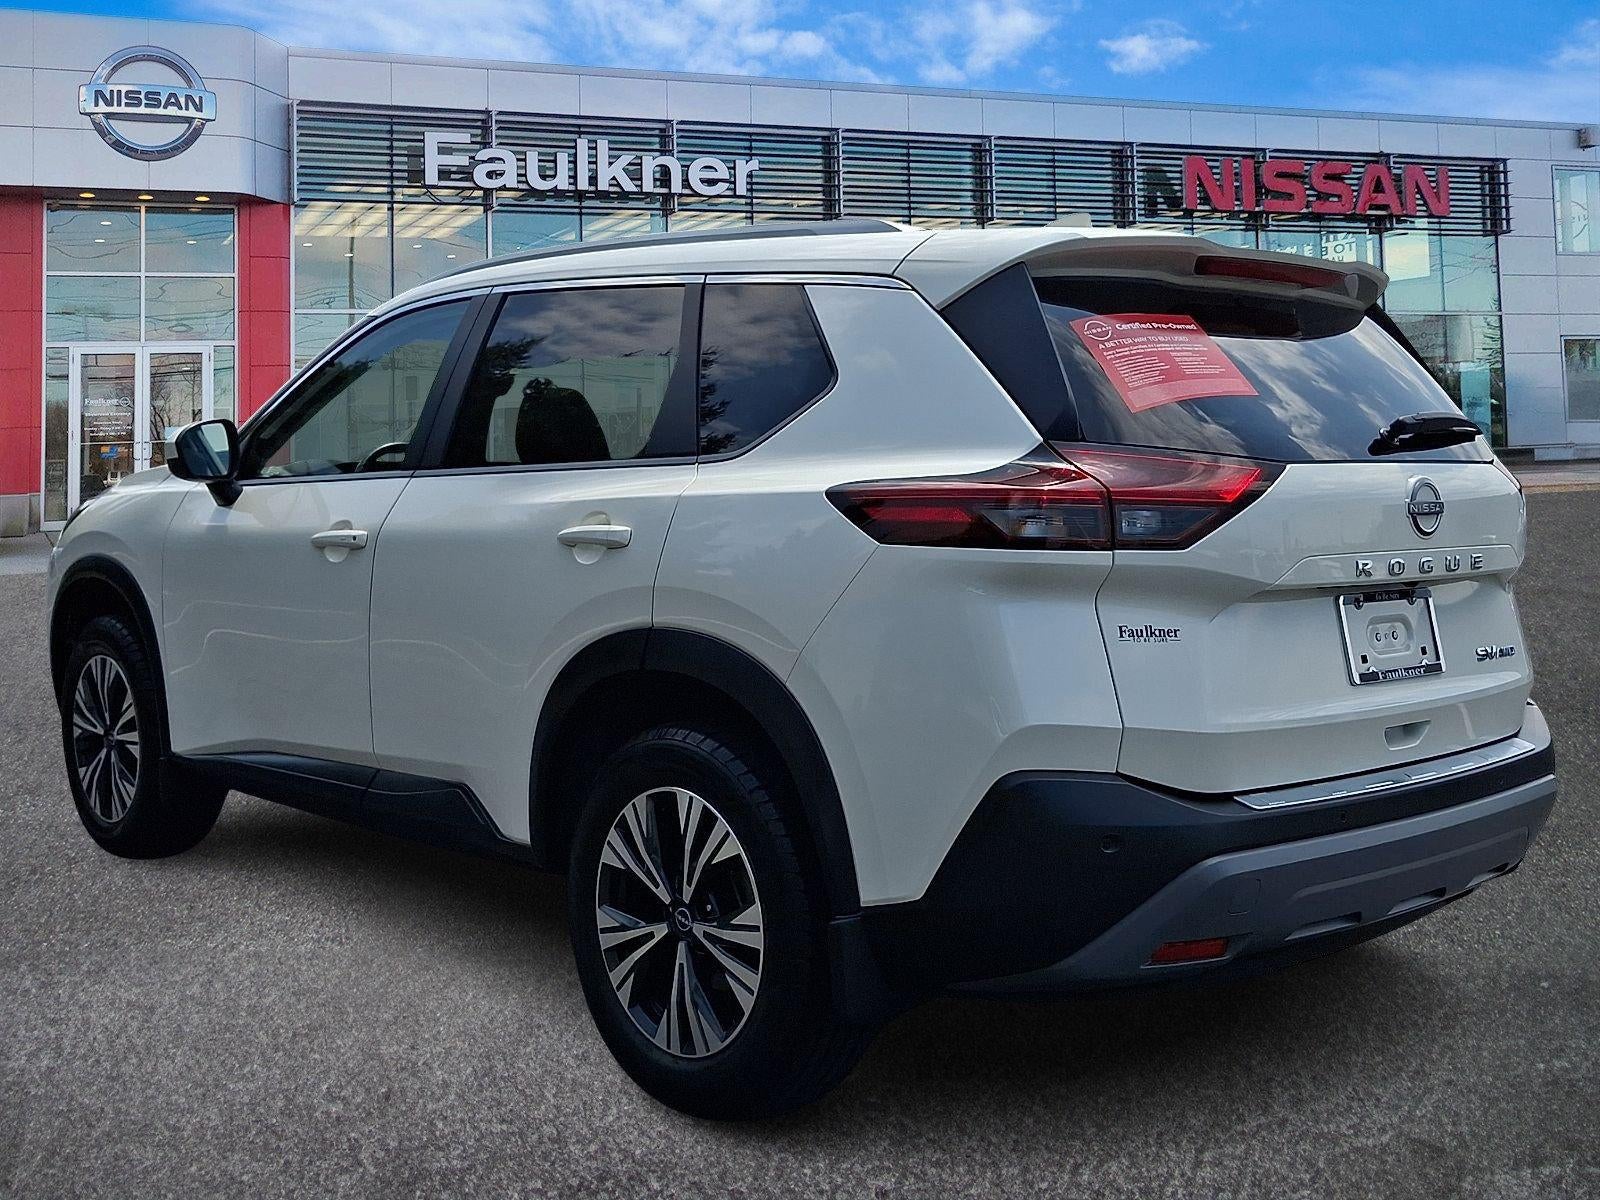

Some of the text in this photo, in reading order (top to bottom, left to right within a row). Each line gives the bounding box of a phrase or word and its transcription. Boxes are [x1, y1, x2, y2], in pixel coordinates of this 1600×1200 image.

[93, 89, 204, 113] NISSAN
[423, 131, 760, 196] Faulkner
[1182, 154, 1451, 217] NISSAN
[1084, 326, 1112, 336] NISSAN
[1115, 322, 1198, 330] Certified Pre-Owned
[1104, 338, 1133, 347] BETTER
[1355, 553, 1484, 577] ROGUE
[1117, 624, 1181, 639] Faulkner
[1377, 665, 1426, 681] Faulkner
